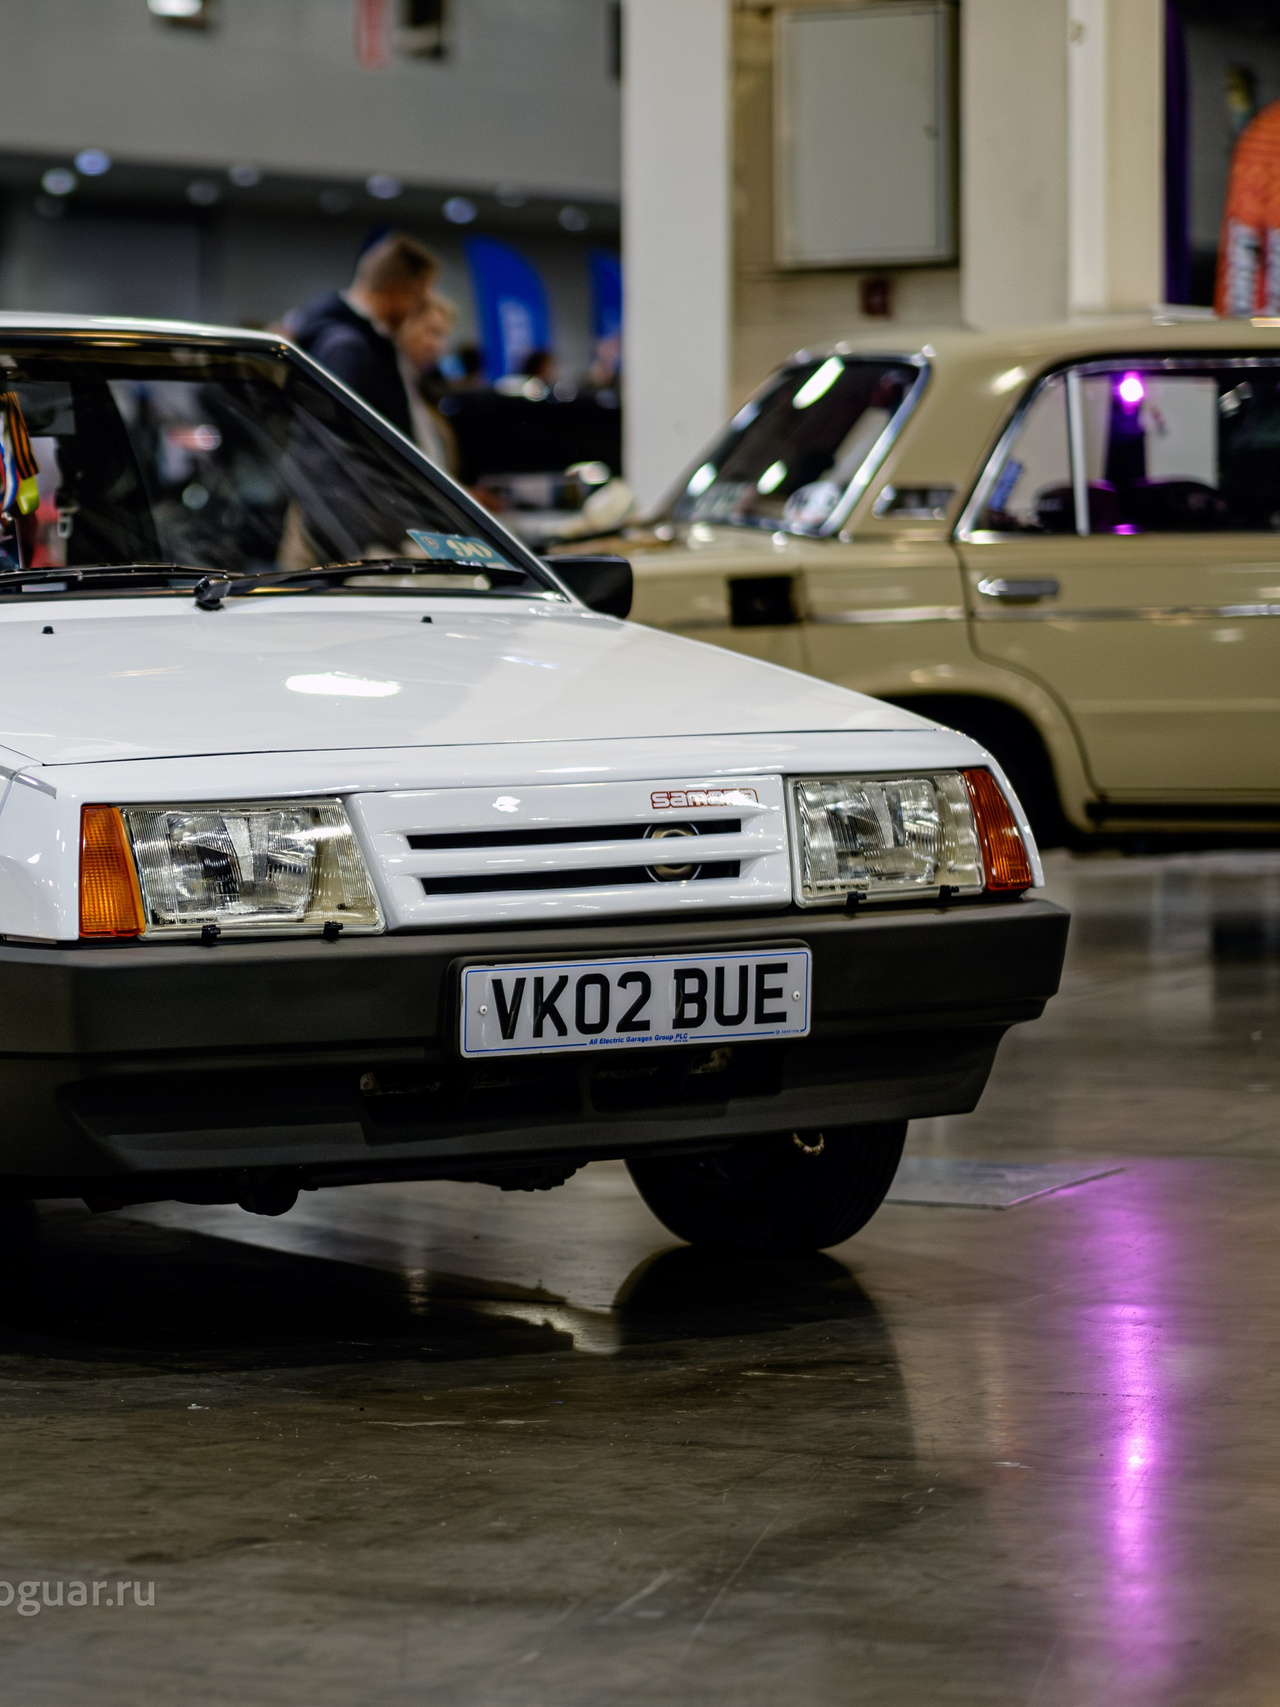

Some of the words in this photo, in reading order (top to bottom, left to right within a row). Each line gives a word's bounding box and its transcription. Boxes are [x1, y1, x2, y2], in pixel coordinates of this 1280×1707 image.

[491, 971, 652, 1040] VK02
[672, 962, 788, 1030] BUE
[599, 1036, 624, 1044] Electric
[654, 1034, 674, 1042] Group
[675, 1032, 688, 1040] PLC
